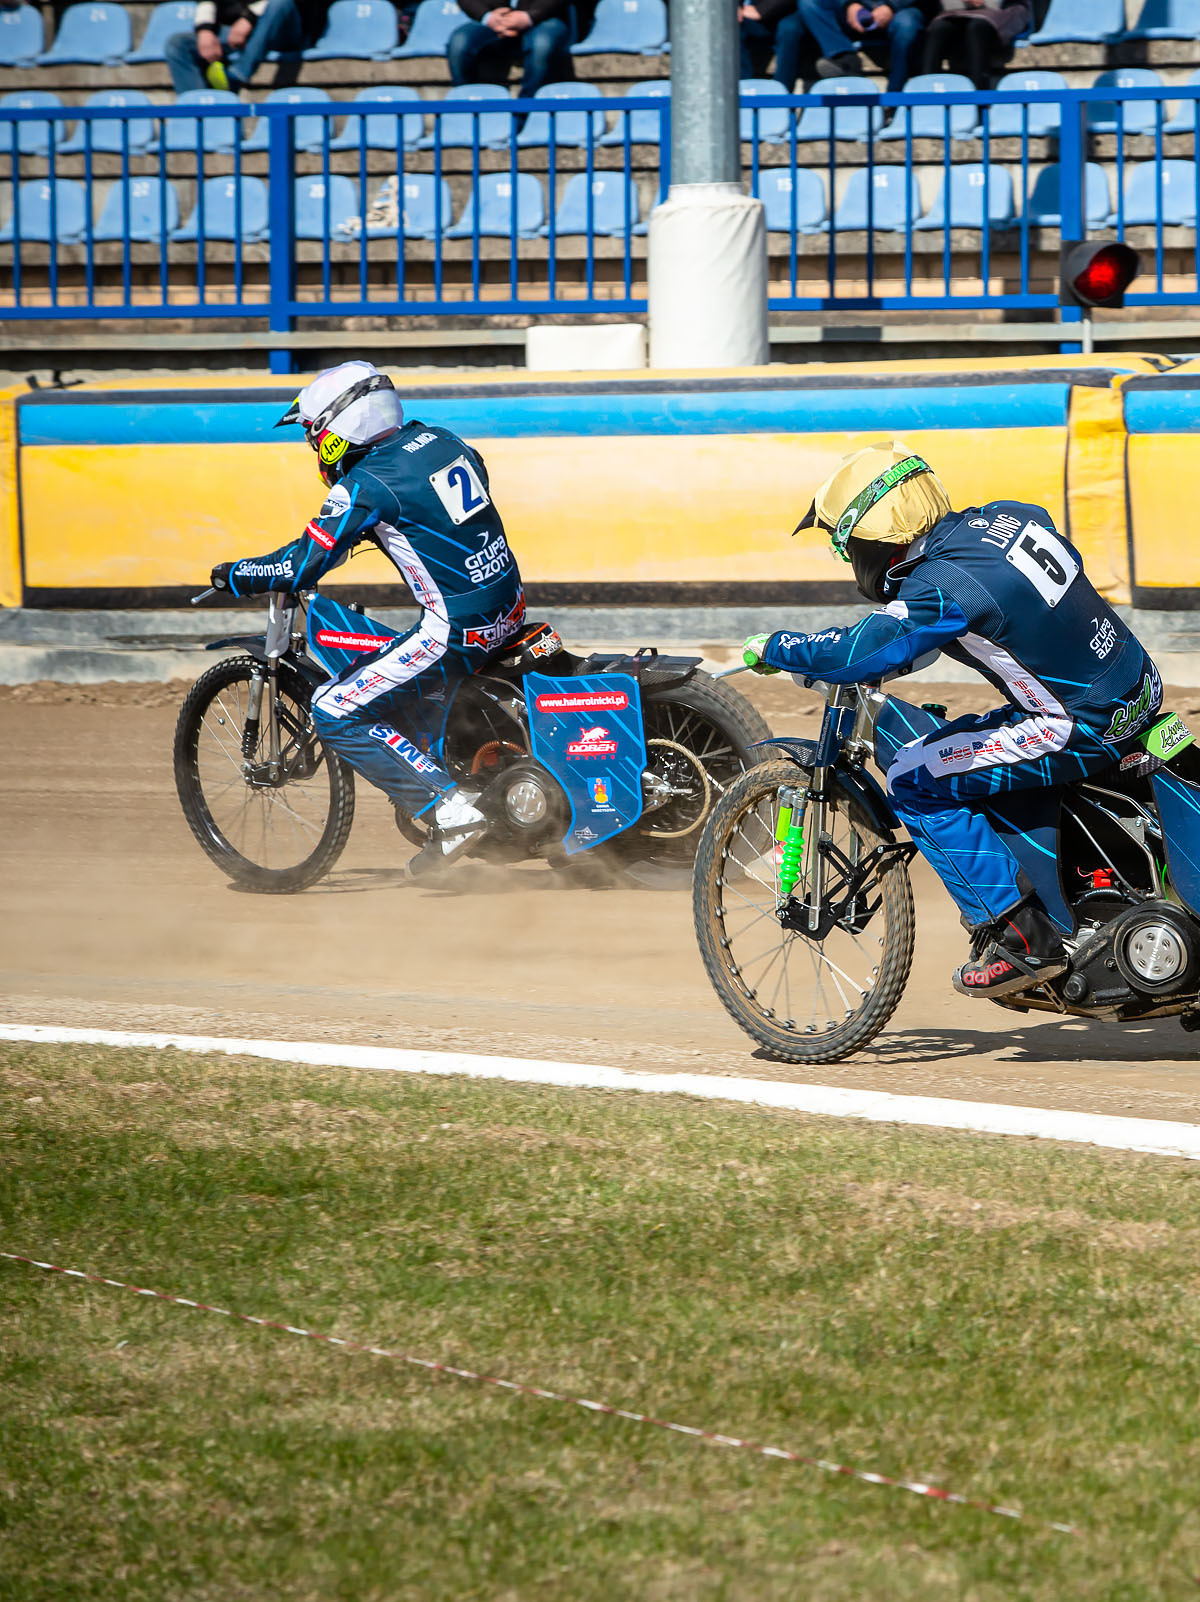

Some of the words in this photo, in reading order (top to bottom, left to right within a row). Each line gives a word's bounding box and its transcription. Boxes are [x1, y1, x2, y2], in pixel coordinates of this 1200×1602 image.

[886, 459, 917, 483] OAKLEY
[447, 465, 483, 514] 2
[981, 514, 1021, 549] LJUNG
[1019, 534, 1067, 586] 5
[540, 695, 625, 707] www.halerolnicki.pl
[568, 743, 616, 753] DOBEK
